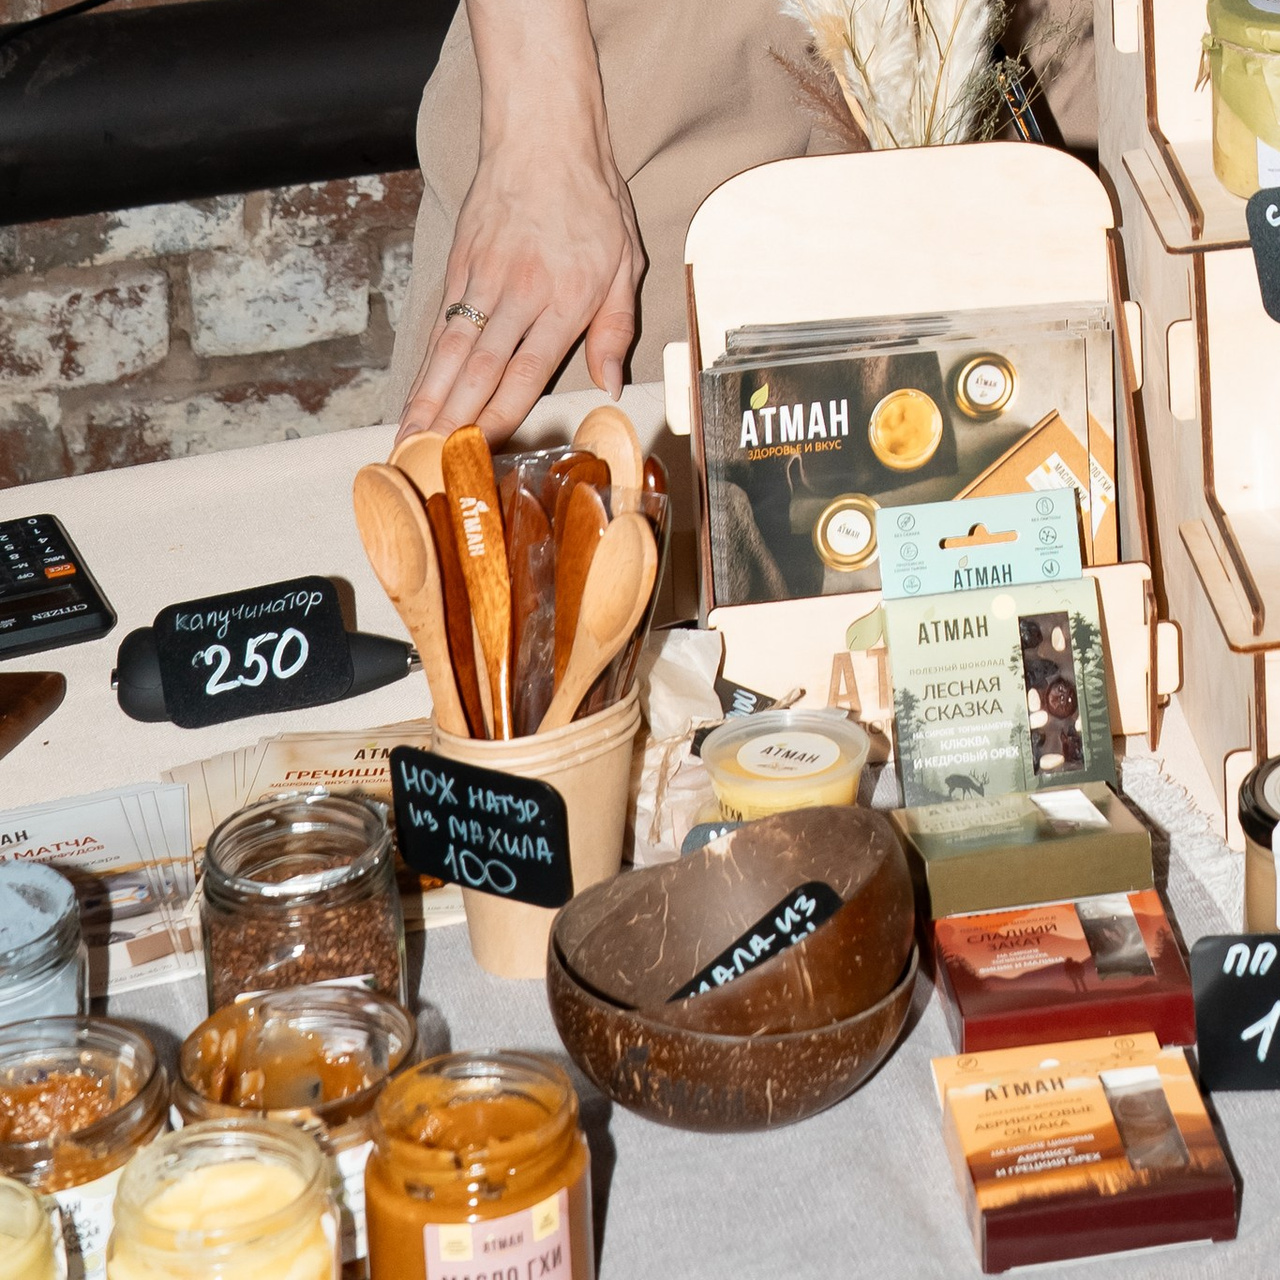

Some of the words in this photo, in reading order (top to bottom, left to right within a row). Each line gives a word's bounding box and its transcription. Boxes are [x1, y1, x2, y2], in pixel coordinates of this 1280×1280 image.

[740, 399, 849, 448] АТМАН
[747, 443, 803, 461] ЗДОРОВЬЕ
[804, 443, 813, 454] И
[815, 439, 842, 453] ВКУС
[459, 496, 487, 557] АТМАН
[953, 563, 1013, 590] АТМАН
[31, 603, 88, 621] CITIZEN
[918, 615, 989, 645] АТМАН
[202, 629, 310, 697] 250
[909, 663, 958, 676] ПОЛЕЗНЫЙ
[960, 658, 1005, 671] ШОКОЛАД
[923, 676, 1001, 701] ЛЕСНАЯ
[924, 699, 1004, 723] СКАЗКА
[760, 742, 821, 764] АТМАН
[940, 734, 990, 752] КЛЮКВА
[924, 749, 988, 769] КЕДРОВЫЙ
[990, 746, 1020, 760] ОРЕХ
[403, 760, 458, 807] НОЖ
[13, 835, 98, 860] МАТЧА
[443, 845, 518, 894] 100
[967, 922, 1058, 944] СЛАДКИЙ
[690, 934, 776, 998] АЛА
[1223, 941, 1277, 977] ПП
[985, 1077, 1065, 1102] АТМАН
[975, 1104, 1094, 1132] АБРИКОСОВЫЕ
[1004, 1119, 1071, 1136] ОБЛАКА
[1017, 1146, 1075, 1164] АБРИКОС
